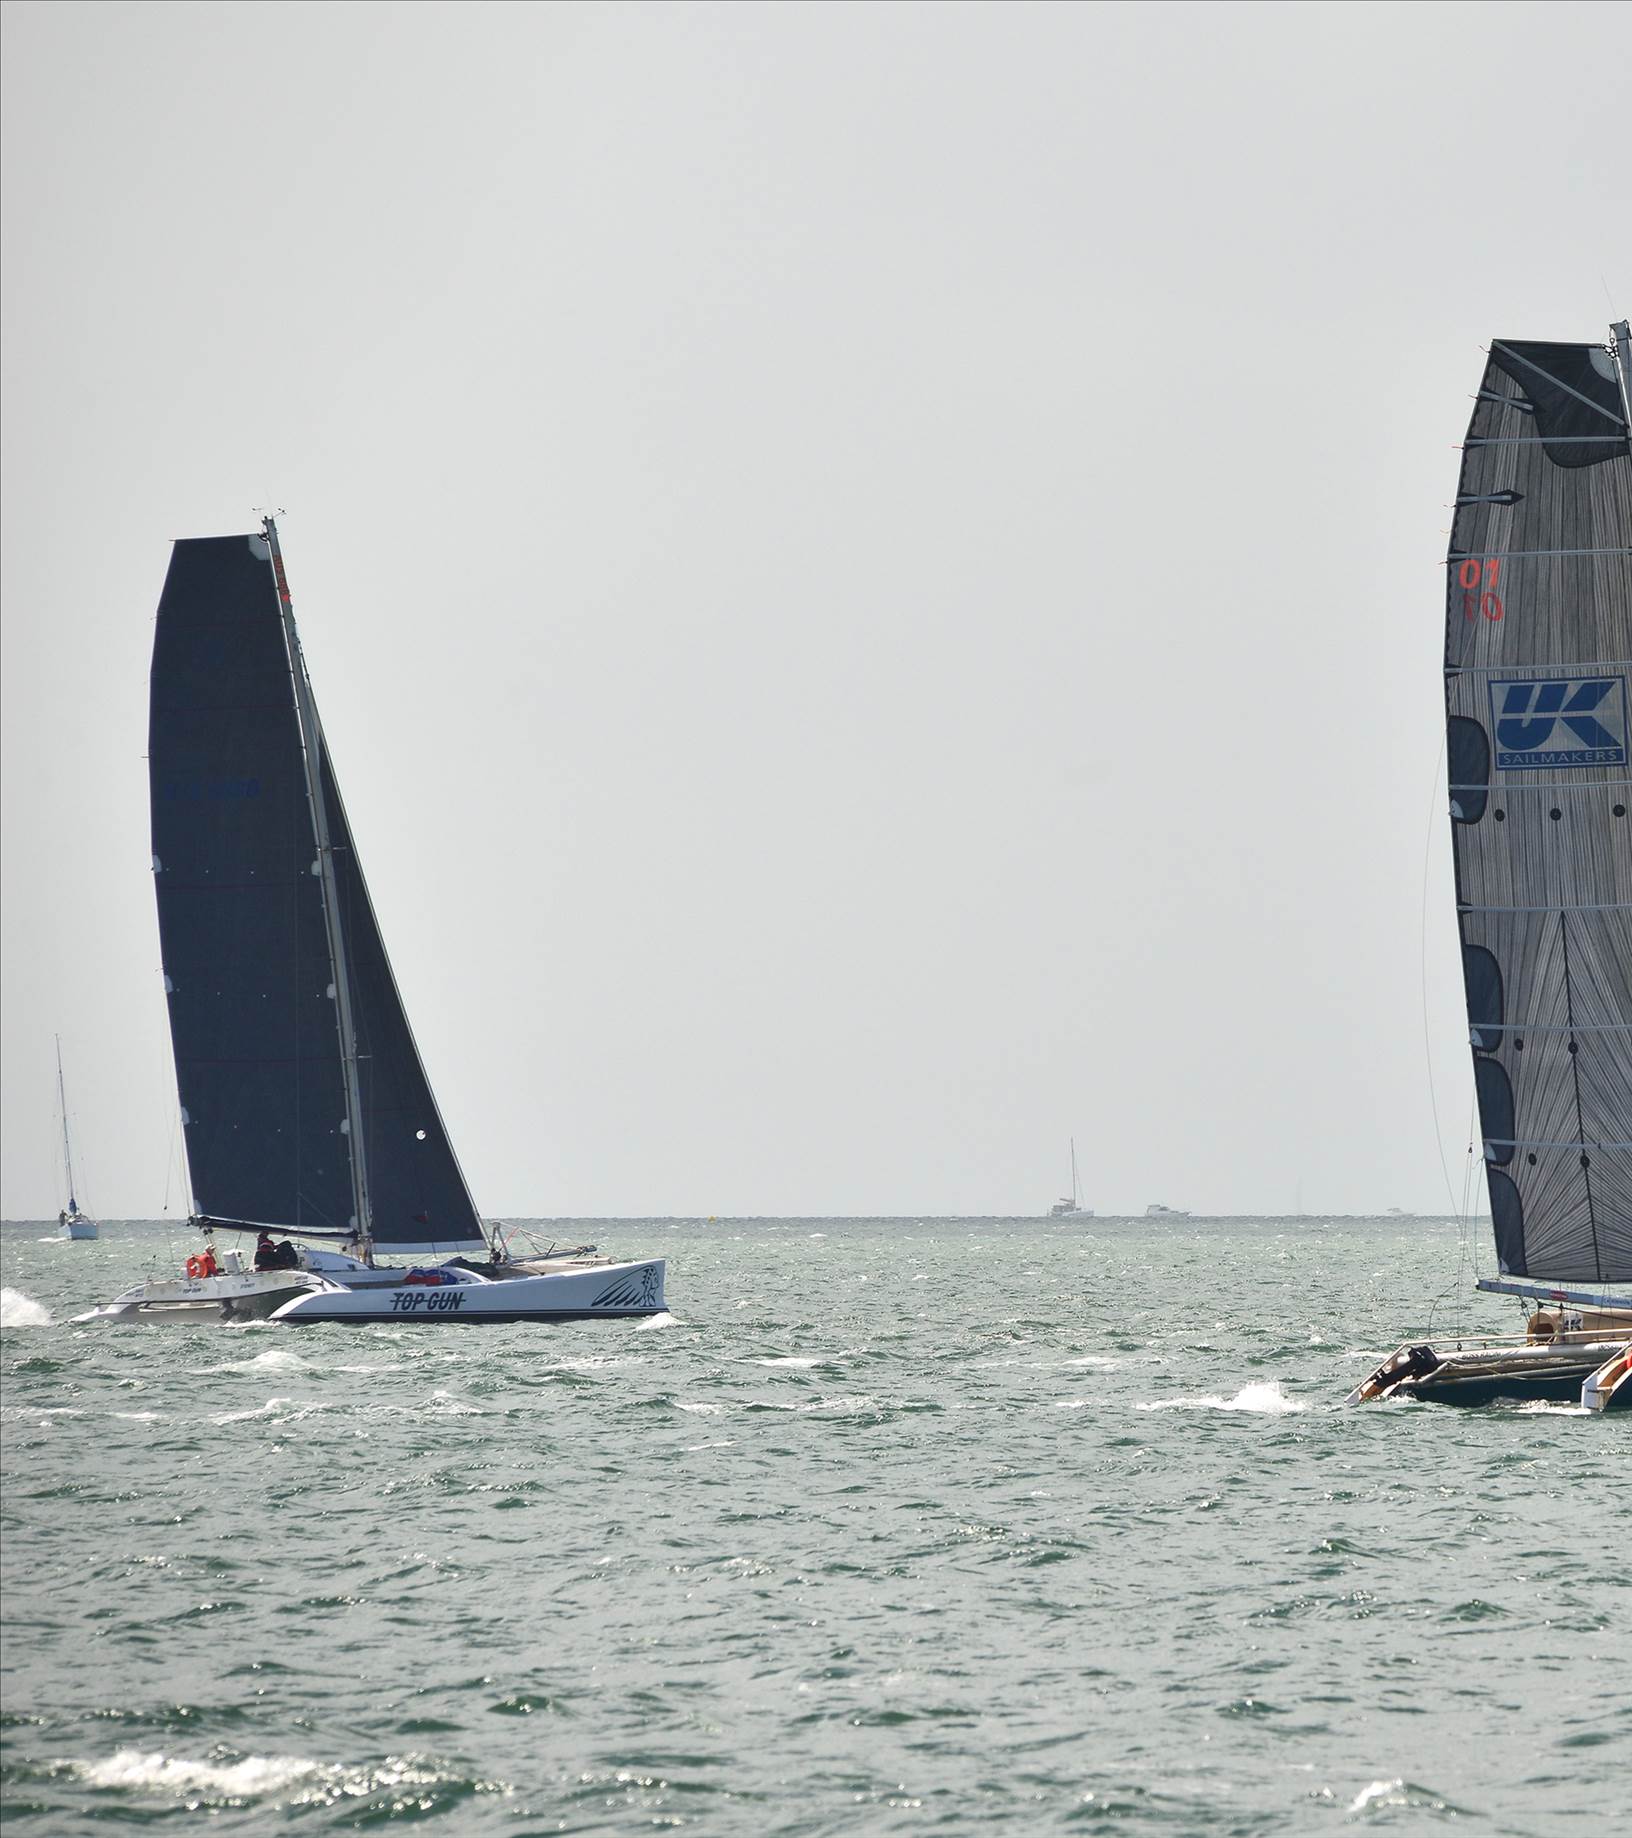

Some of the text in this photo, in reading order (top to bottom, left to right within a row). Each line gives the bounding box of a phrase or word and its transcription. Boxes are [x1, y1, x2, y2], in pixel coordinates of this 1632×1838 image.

[1497, 681, 1622, 750] UK
[1503, 750, 1618, 764] SAILMAKERS
[391, 1292, 465, 1311] TOP GUN
